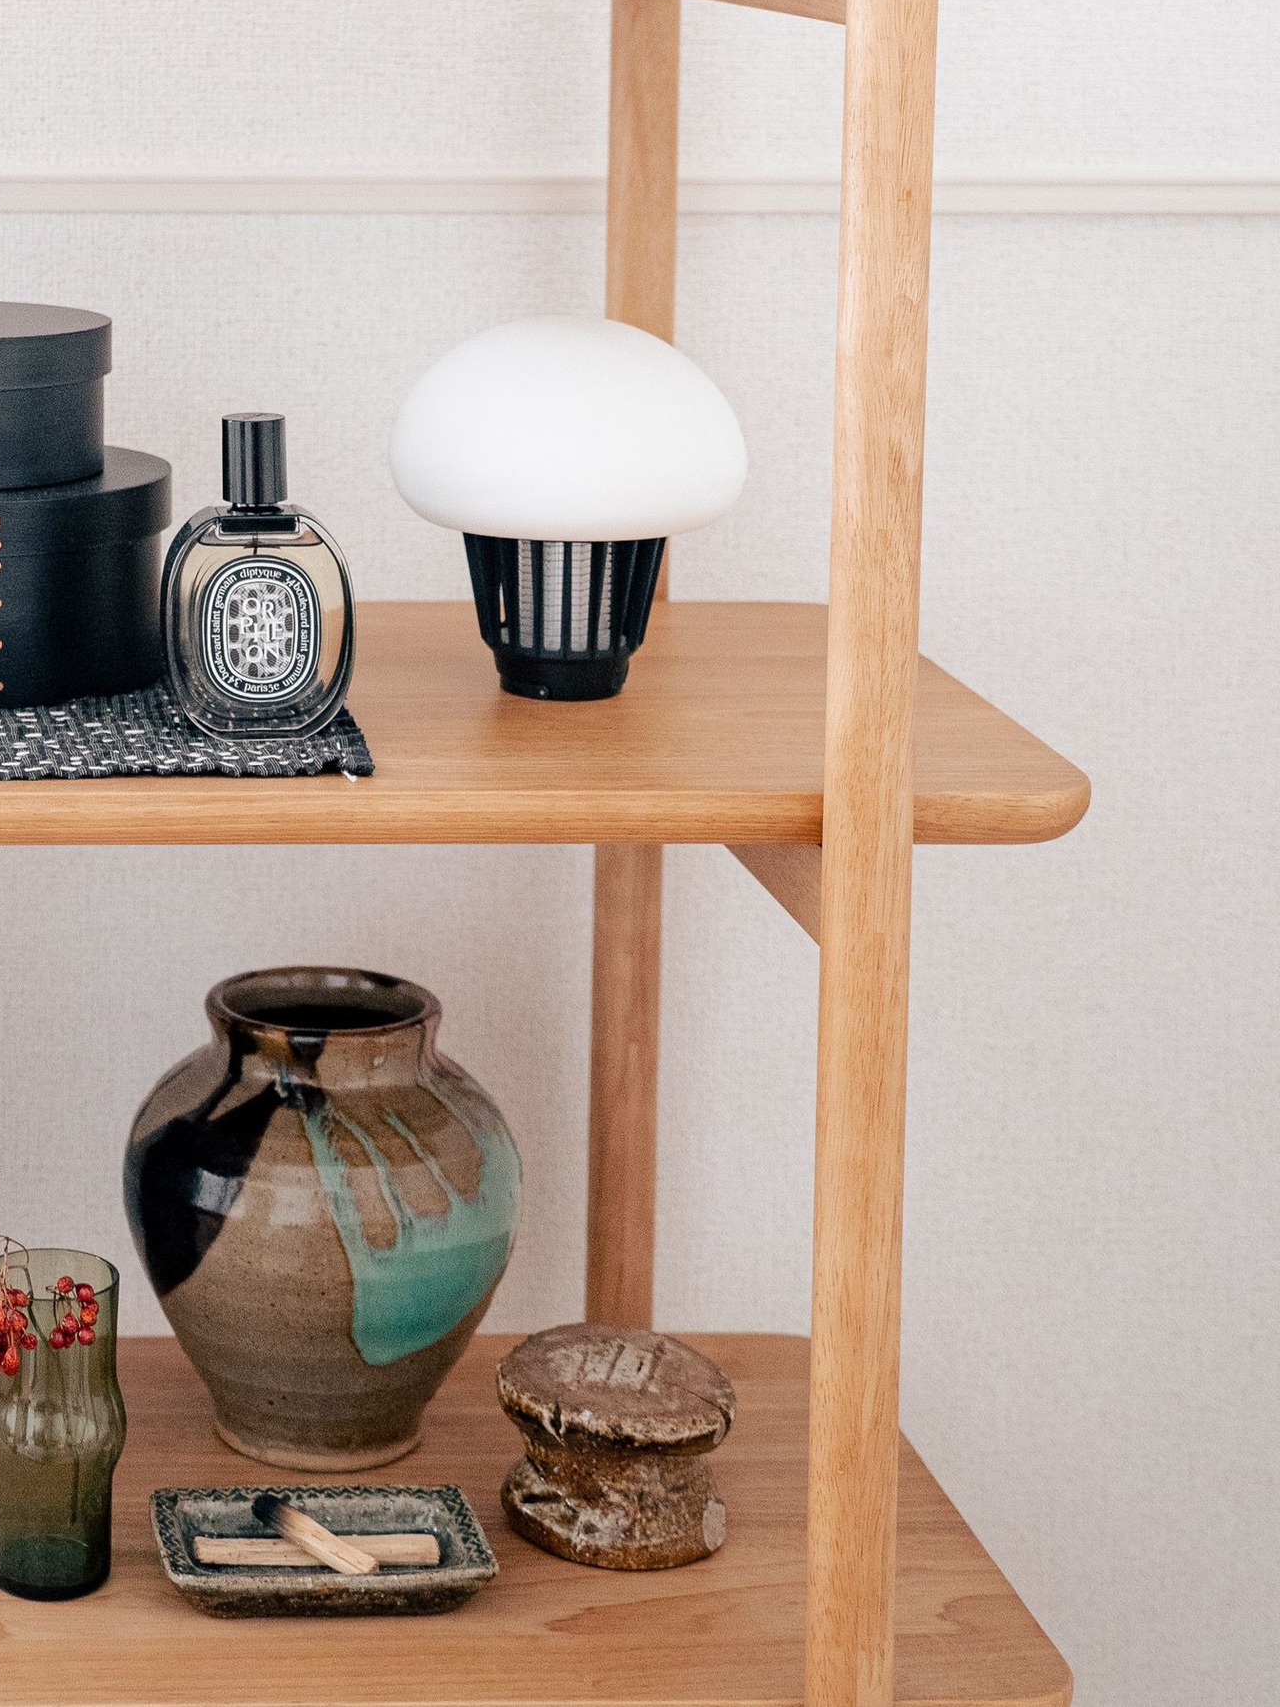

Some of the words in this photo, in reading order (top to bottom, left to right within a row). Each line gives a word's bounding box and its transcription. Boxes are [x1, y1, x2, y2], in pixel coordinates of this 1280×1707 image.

[239, 567, 282, 580] diptyque
[214, 574, 237, 610] germain
[242, 597, 276, 621] OR
[292, 580, 310, 629] boulevard
[211, 610, 221, 634] saint
[246, 642, 281, 663] ON
[300, 629, 310, 653] saint
[212, 634, 230, 680] boulevard
[282, 653, 306, 687] germain
